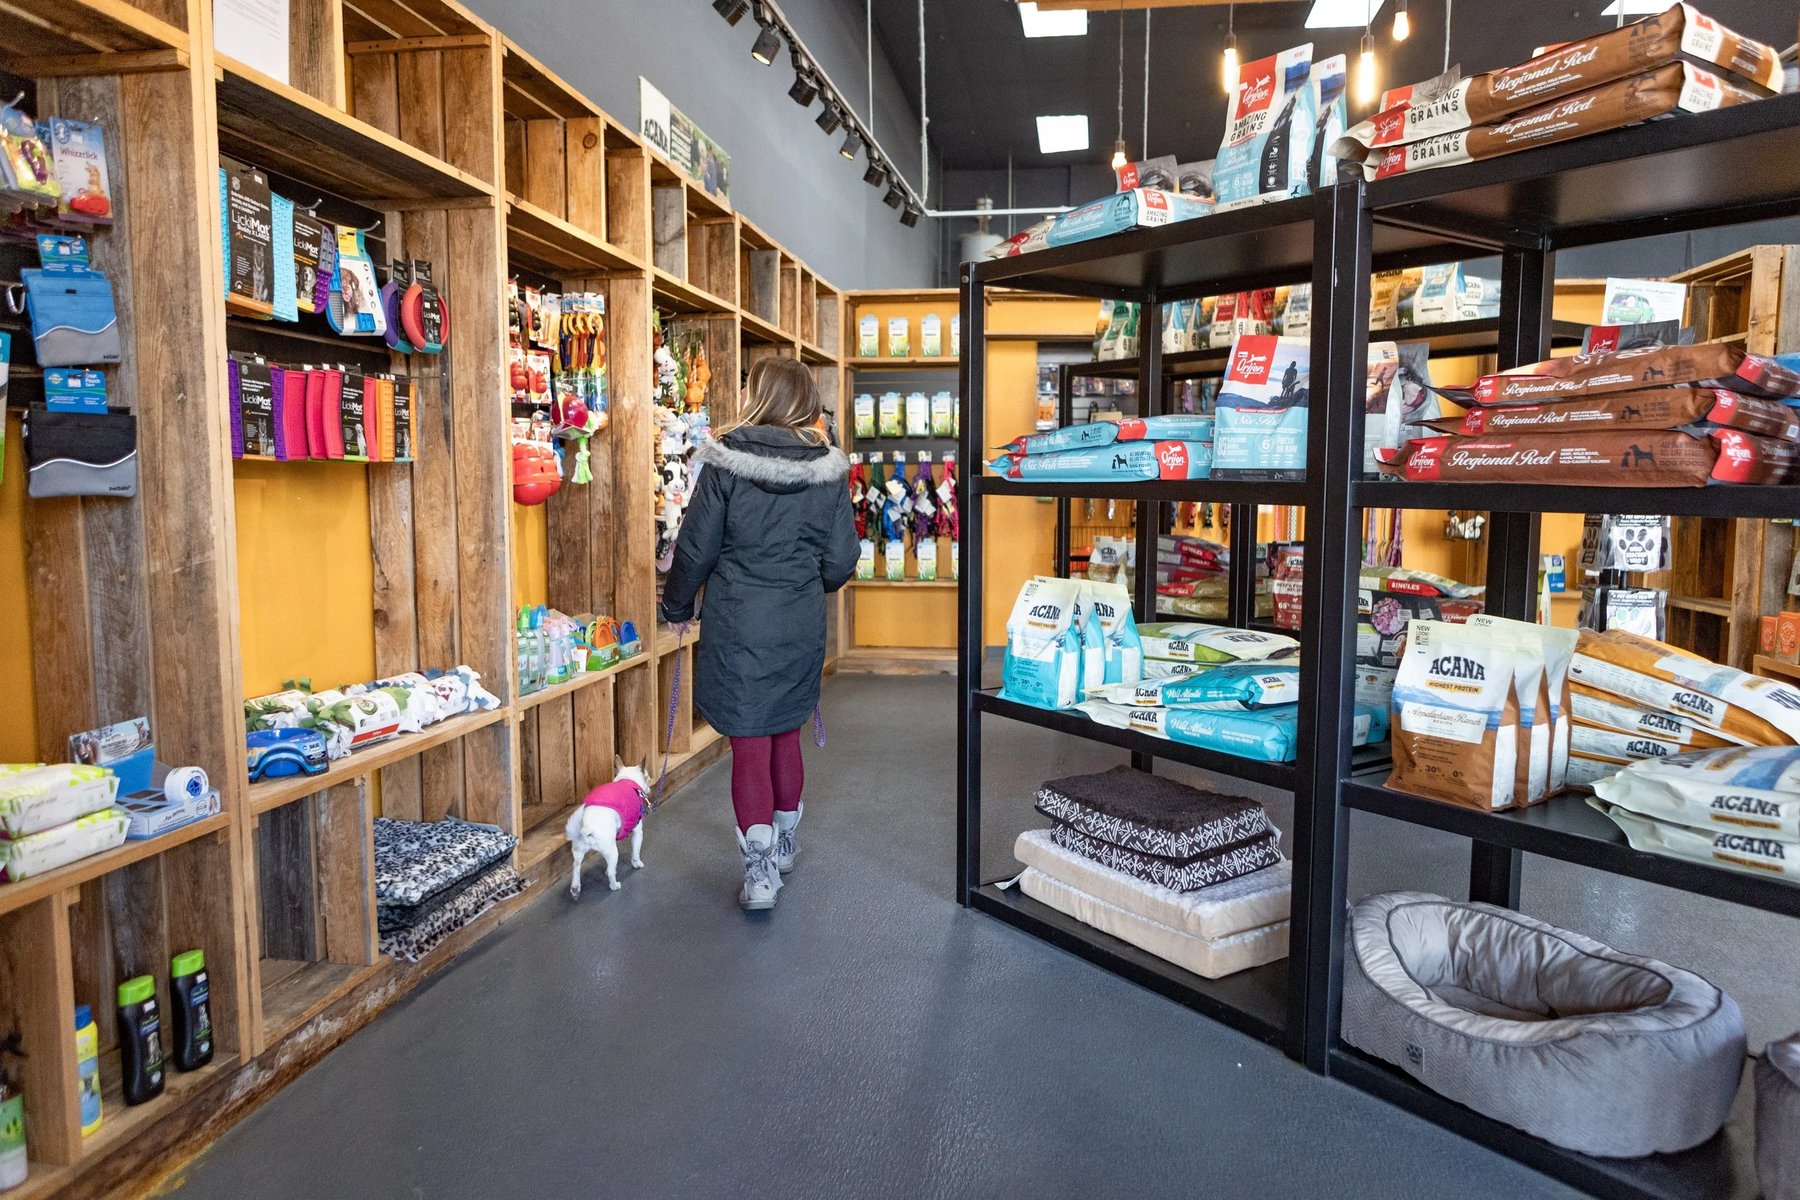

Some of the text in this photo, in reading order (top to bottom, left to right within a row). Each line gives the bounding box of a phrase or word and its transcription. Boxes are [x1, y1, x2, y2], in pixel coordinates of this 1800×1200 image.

[1493, 60, 1560, 93] Regional
[1559, 46, 1598, 71] Red
[1243, 87, 1270, 107] Orijen
[1557, 96, 1597, 118] Red
[1234, 112, 1267, 132] AMAZING
[1410, 100, 1459, 124] GRAINS
[644, 119, 669, 154] ACANA
[1230, 122, 1264, 142] GRAINS
[1412, 140, 1460, 161] GRAINS
[1237, 358, 1265, 378] Orijen
[1502, 380, 1560, 397] Regional
[1489, 412, 1541, 426] Regional
[1537, 411, 1570, 424] Red
[1024, 459, 1038, 470] Six
[1038, 458, 1058, 470] Fish
[1161, 453, 1186, 470] Orijen
[1409, 452, 1435, 473] Orijen
[1448, 449, 1555, 470] Regional Red
[109, 485, 131, 493] PetSafe
[1094, 602, 1115, 618] ANA
[1476, 617, 1493, 625] NEW
[1168, 641, 1190, 651] ACANA
[1429, 656, 1485, 680] ACANA
[1429, 681, 1480, 693] HIGHEST PROTEIN
[1672, 692, 1713, 715] ACANA
[1407, 707, 1482, 727] Appalachian Ranch
[1639, 714, 1682, 733] ACANA
[1170, 719, 1216, 736] Wild Atlantic
[1626, 741, 1667, 757] ACANA
[1425, 764, 1441, 774] 30%
[1710, 796, 1781, 818] ACANA
[1713, 833, 1785, 859] ACANA
